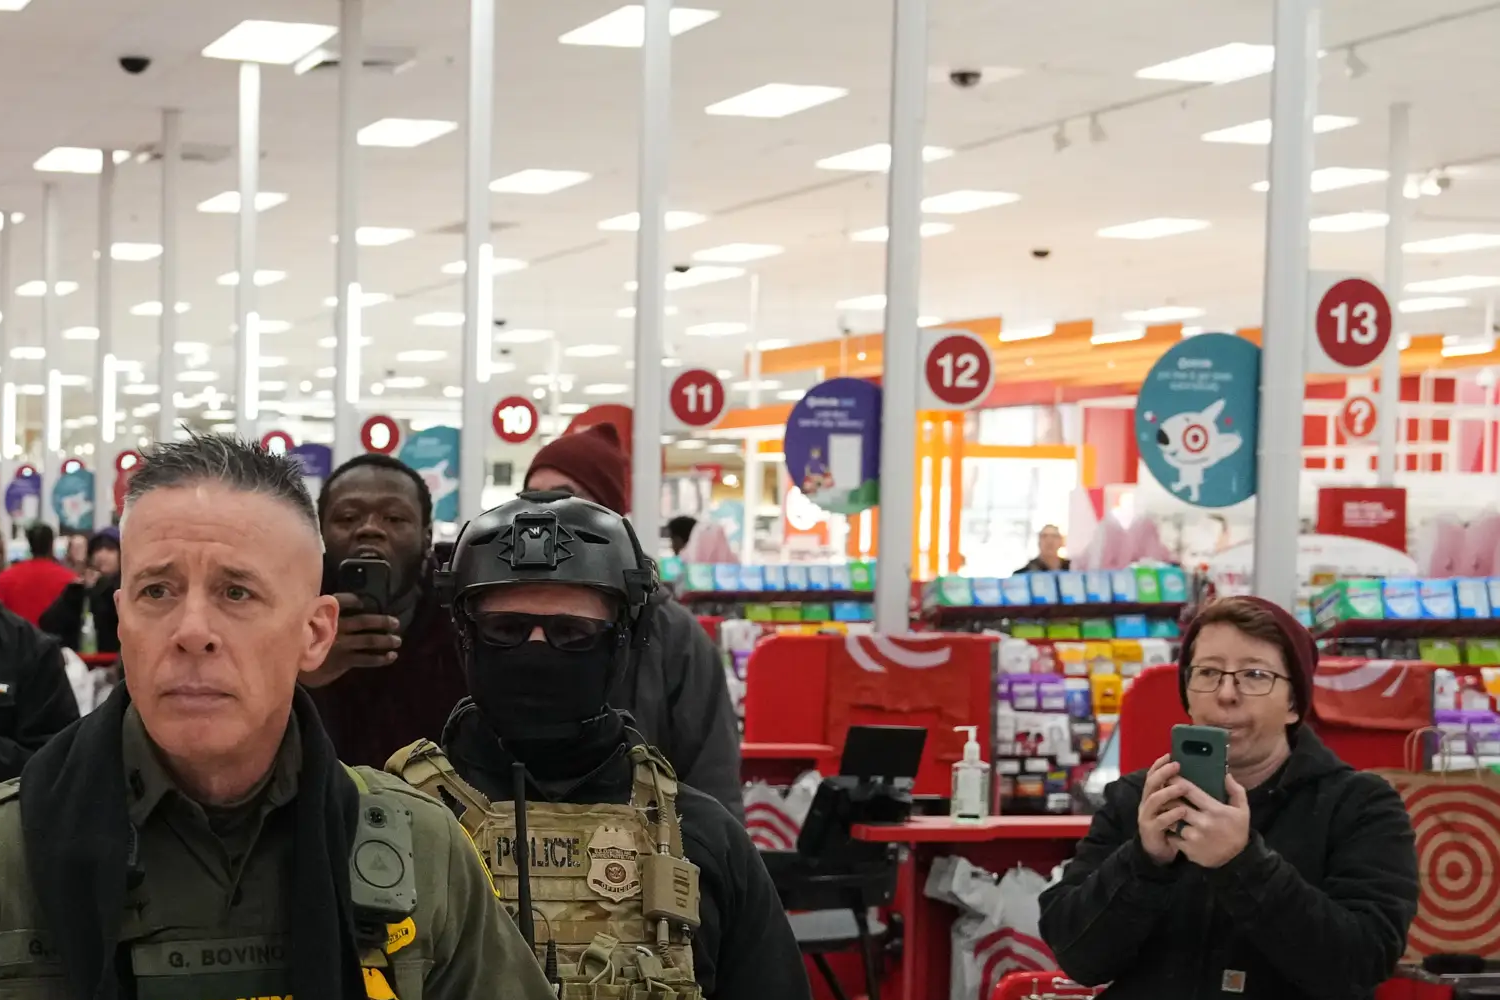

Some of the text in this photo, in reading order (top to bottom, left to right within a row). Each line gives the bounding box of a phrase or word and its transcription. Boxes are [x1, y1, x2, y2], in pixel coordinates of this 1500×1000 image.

[1330, 301, 1378, 345] 13
[936, 352, 980, 388] 12
[682, 383, 714, 413] 11
[499, 404, 532, 433] 10
[168, 951, 190, 968] G.
